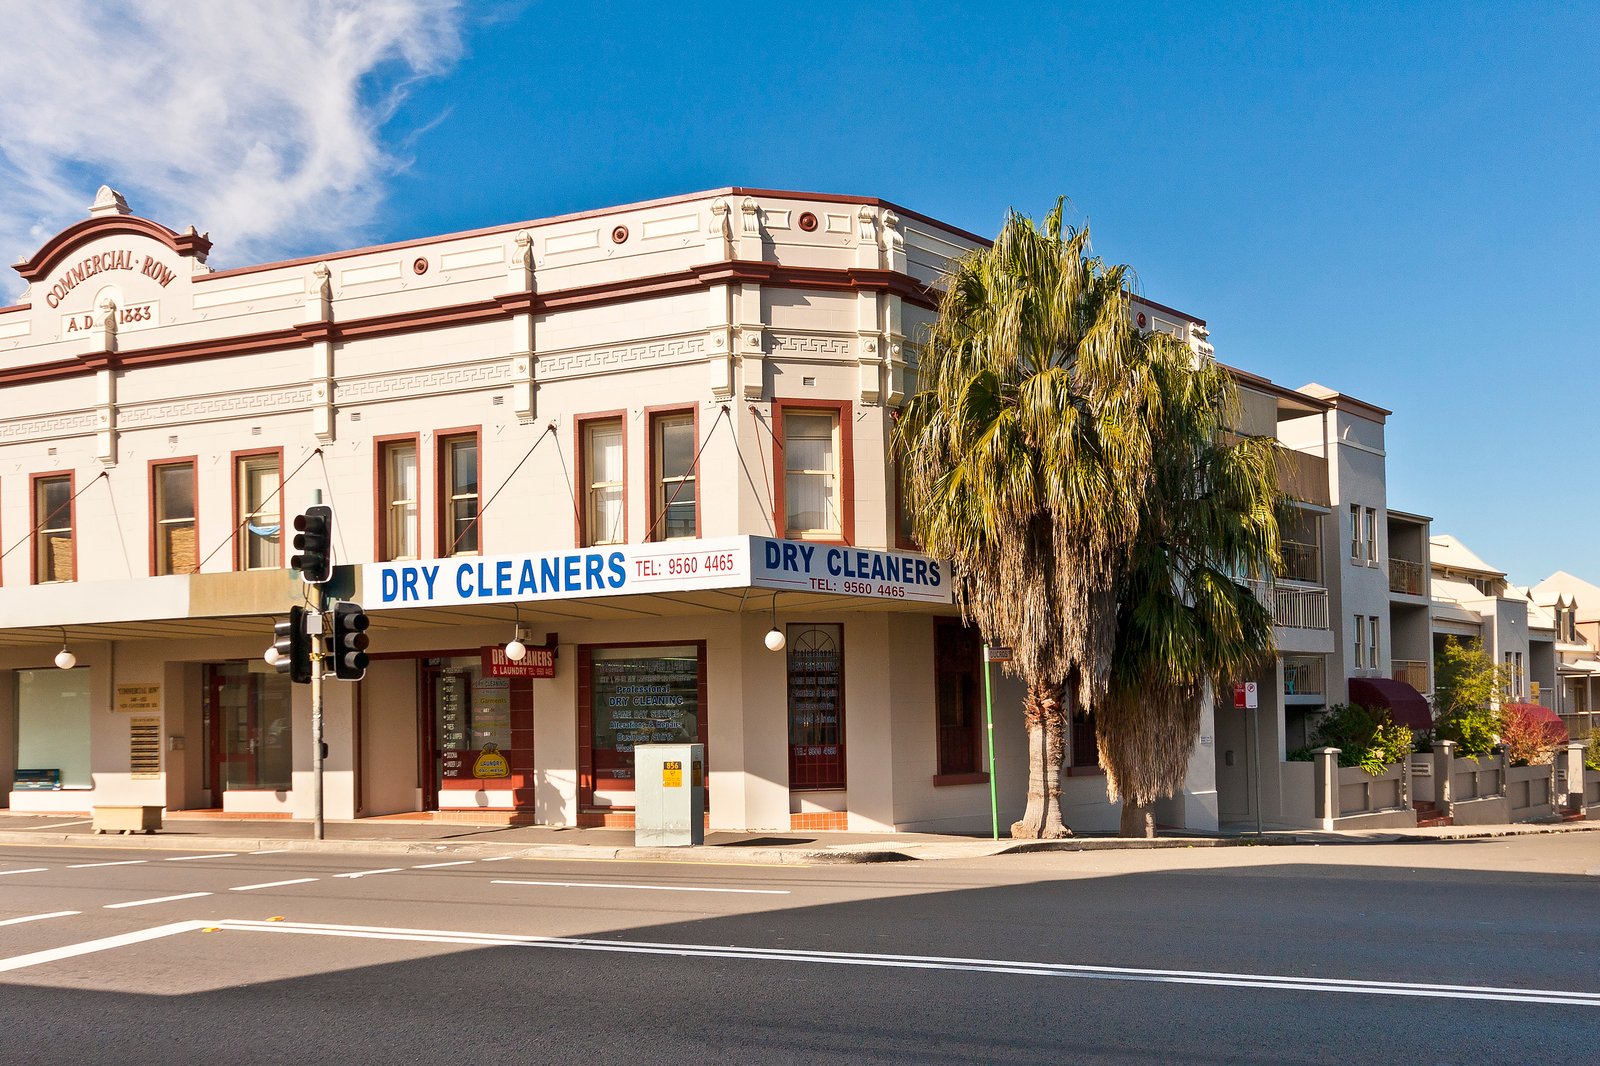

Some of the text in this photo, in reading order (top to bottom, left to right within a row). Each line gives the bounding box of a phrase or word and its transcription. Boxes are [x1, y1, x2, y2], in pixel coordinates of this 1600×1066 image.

[46, 250, 176, 309] COMMERCIAL ROW
[119, 306, 152, 325] 1883
[764, 540, 942, 587] DRY CLEANERS
[381, 551, 734, 603] DRY CLEANERS TEL: 9560 4465
[808, 576, 906, 599] TEL: 9560 4465
[492, 666, 498, 674] &
[499, 666, 527, 675] LAUNDRY
[616, 684, 671, 694] Professional
[609, 696, 683, 706] DRY CLEANING
[612, 709, 679, 719] SAME DAY SERVICE
[609, 721, 646, 729] Alterations
[656, 721, 682, 729] Repairs
[617, 733, 649, 741] Business
